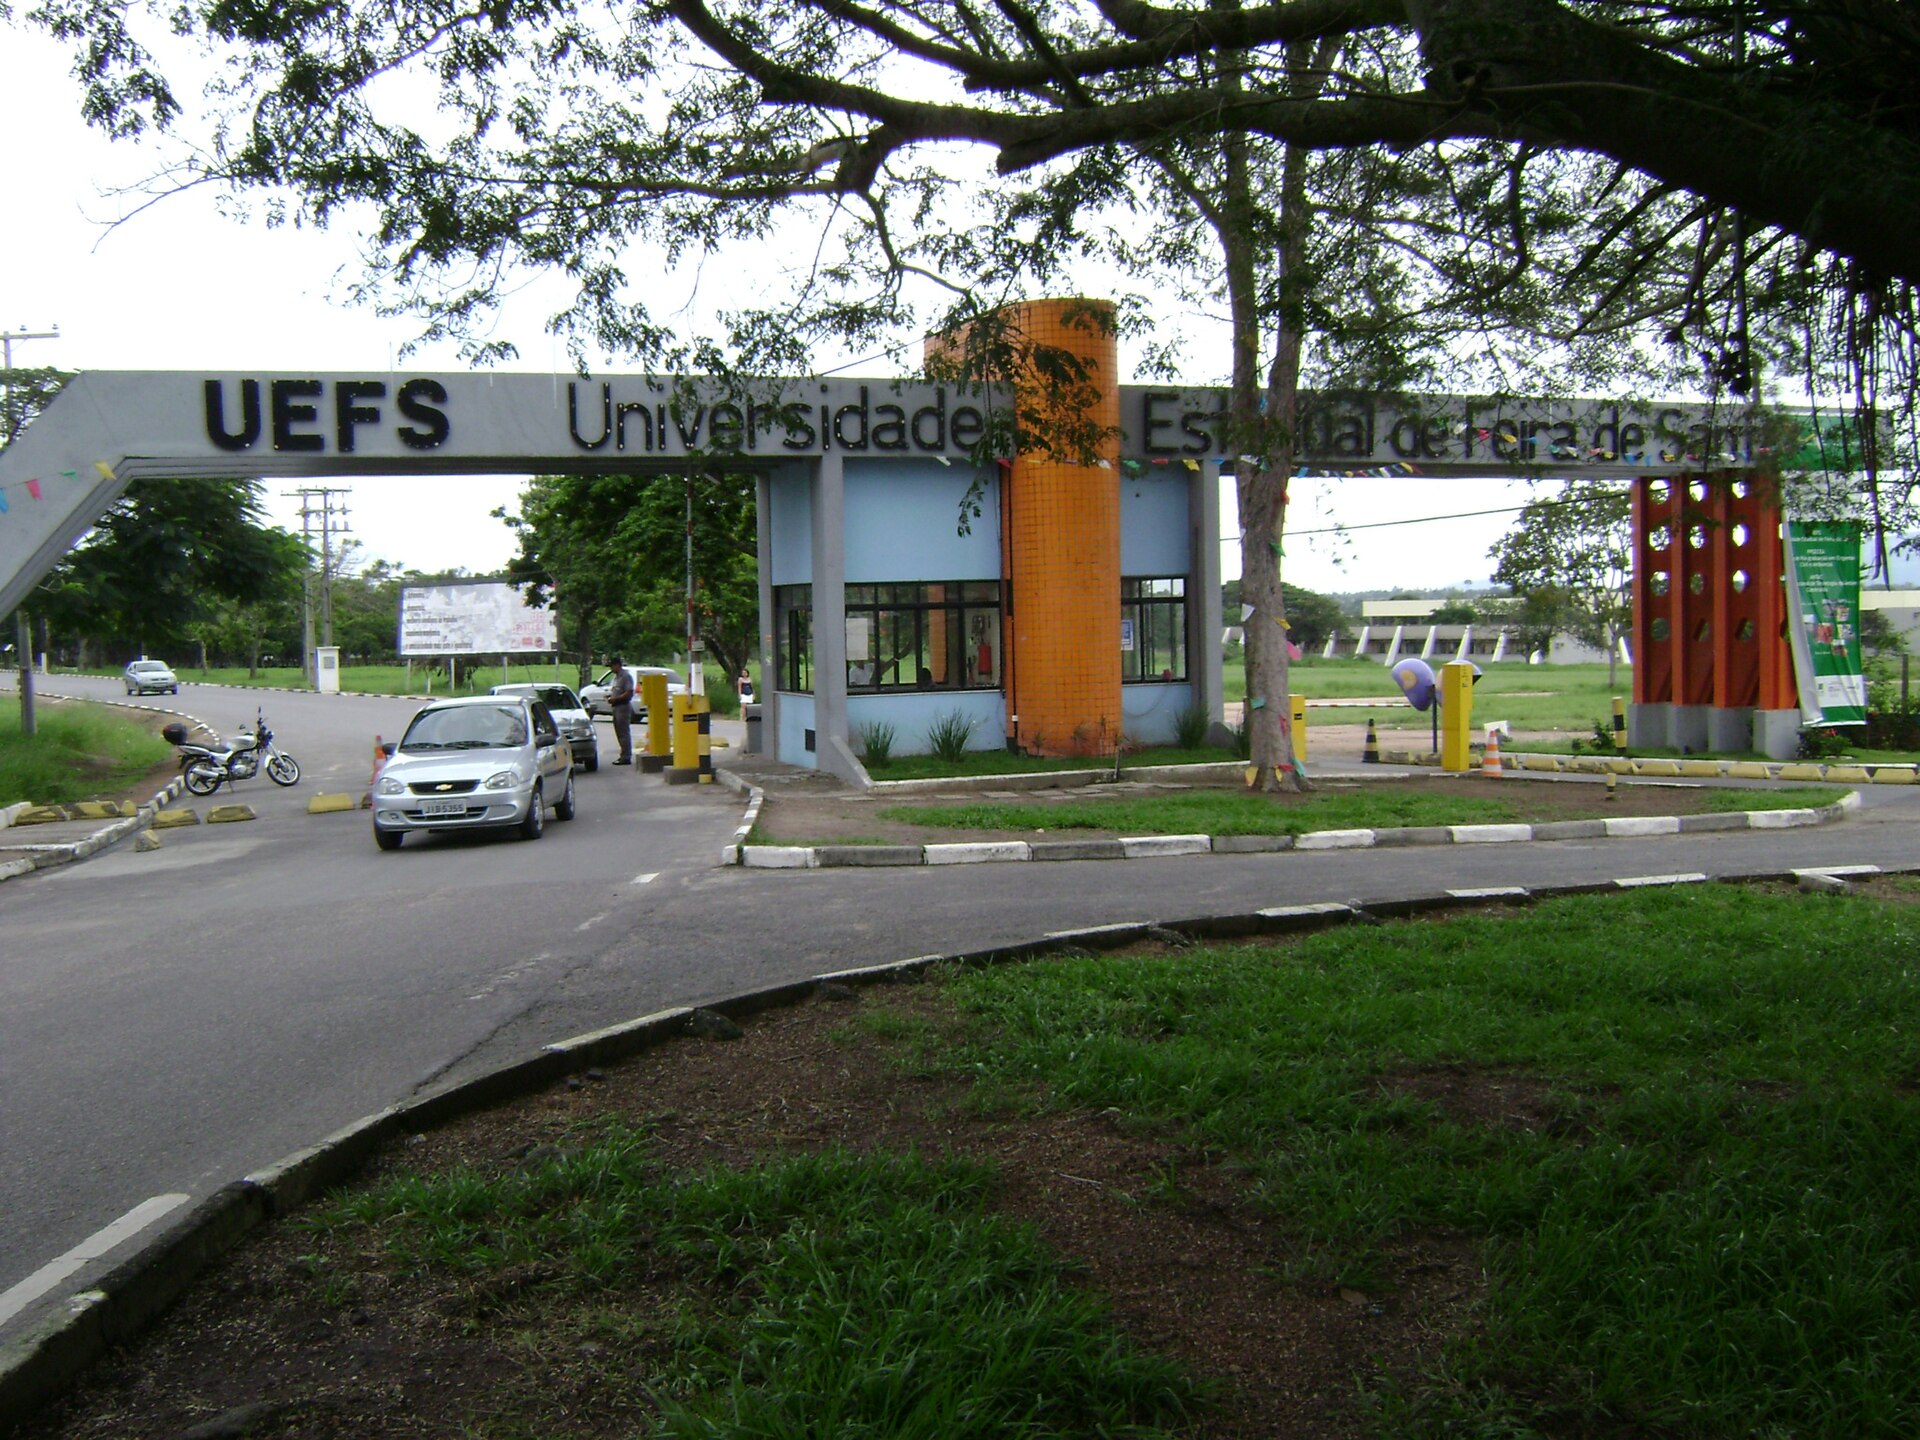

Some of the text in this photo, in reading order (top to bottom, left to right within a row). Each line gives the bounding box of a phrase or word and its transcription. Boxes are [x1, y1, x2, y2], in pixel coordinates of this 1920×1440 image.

[204, 378, 450, 453] UEFS
[568, 381, 985, 452] Universidade
[1144, 392, 1376, 457] Estual
[1592, 403, 1646, 462] de
